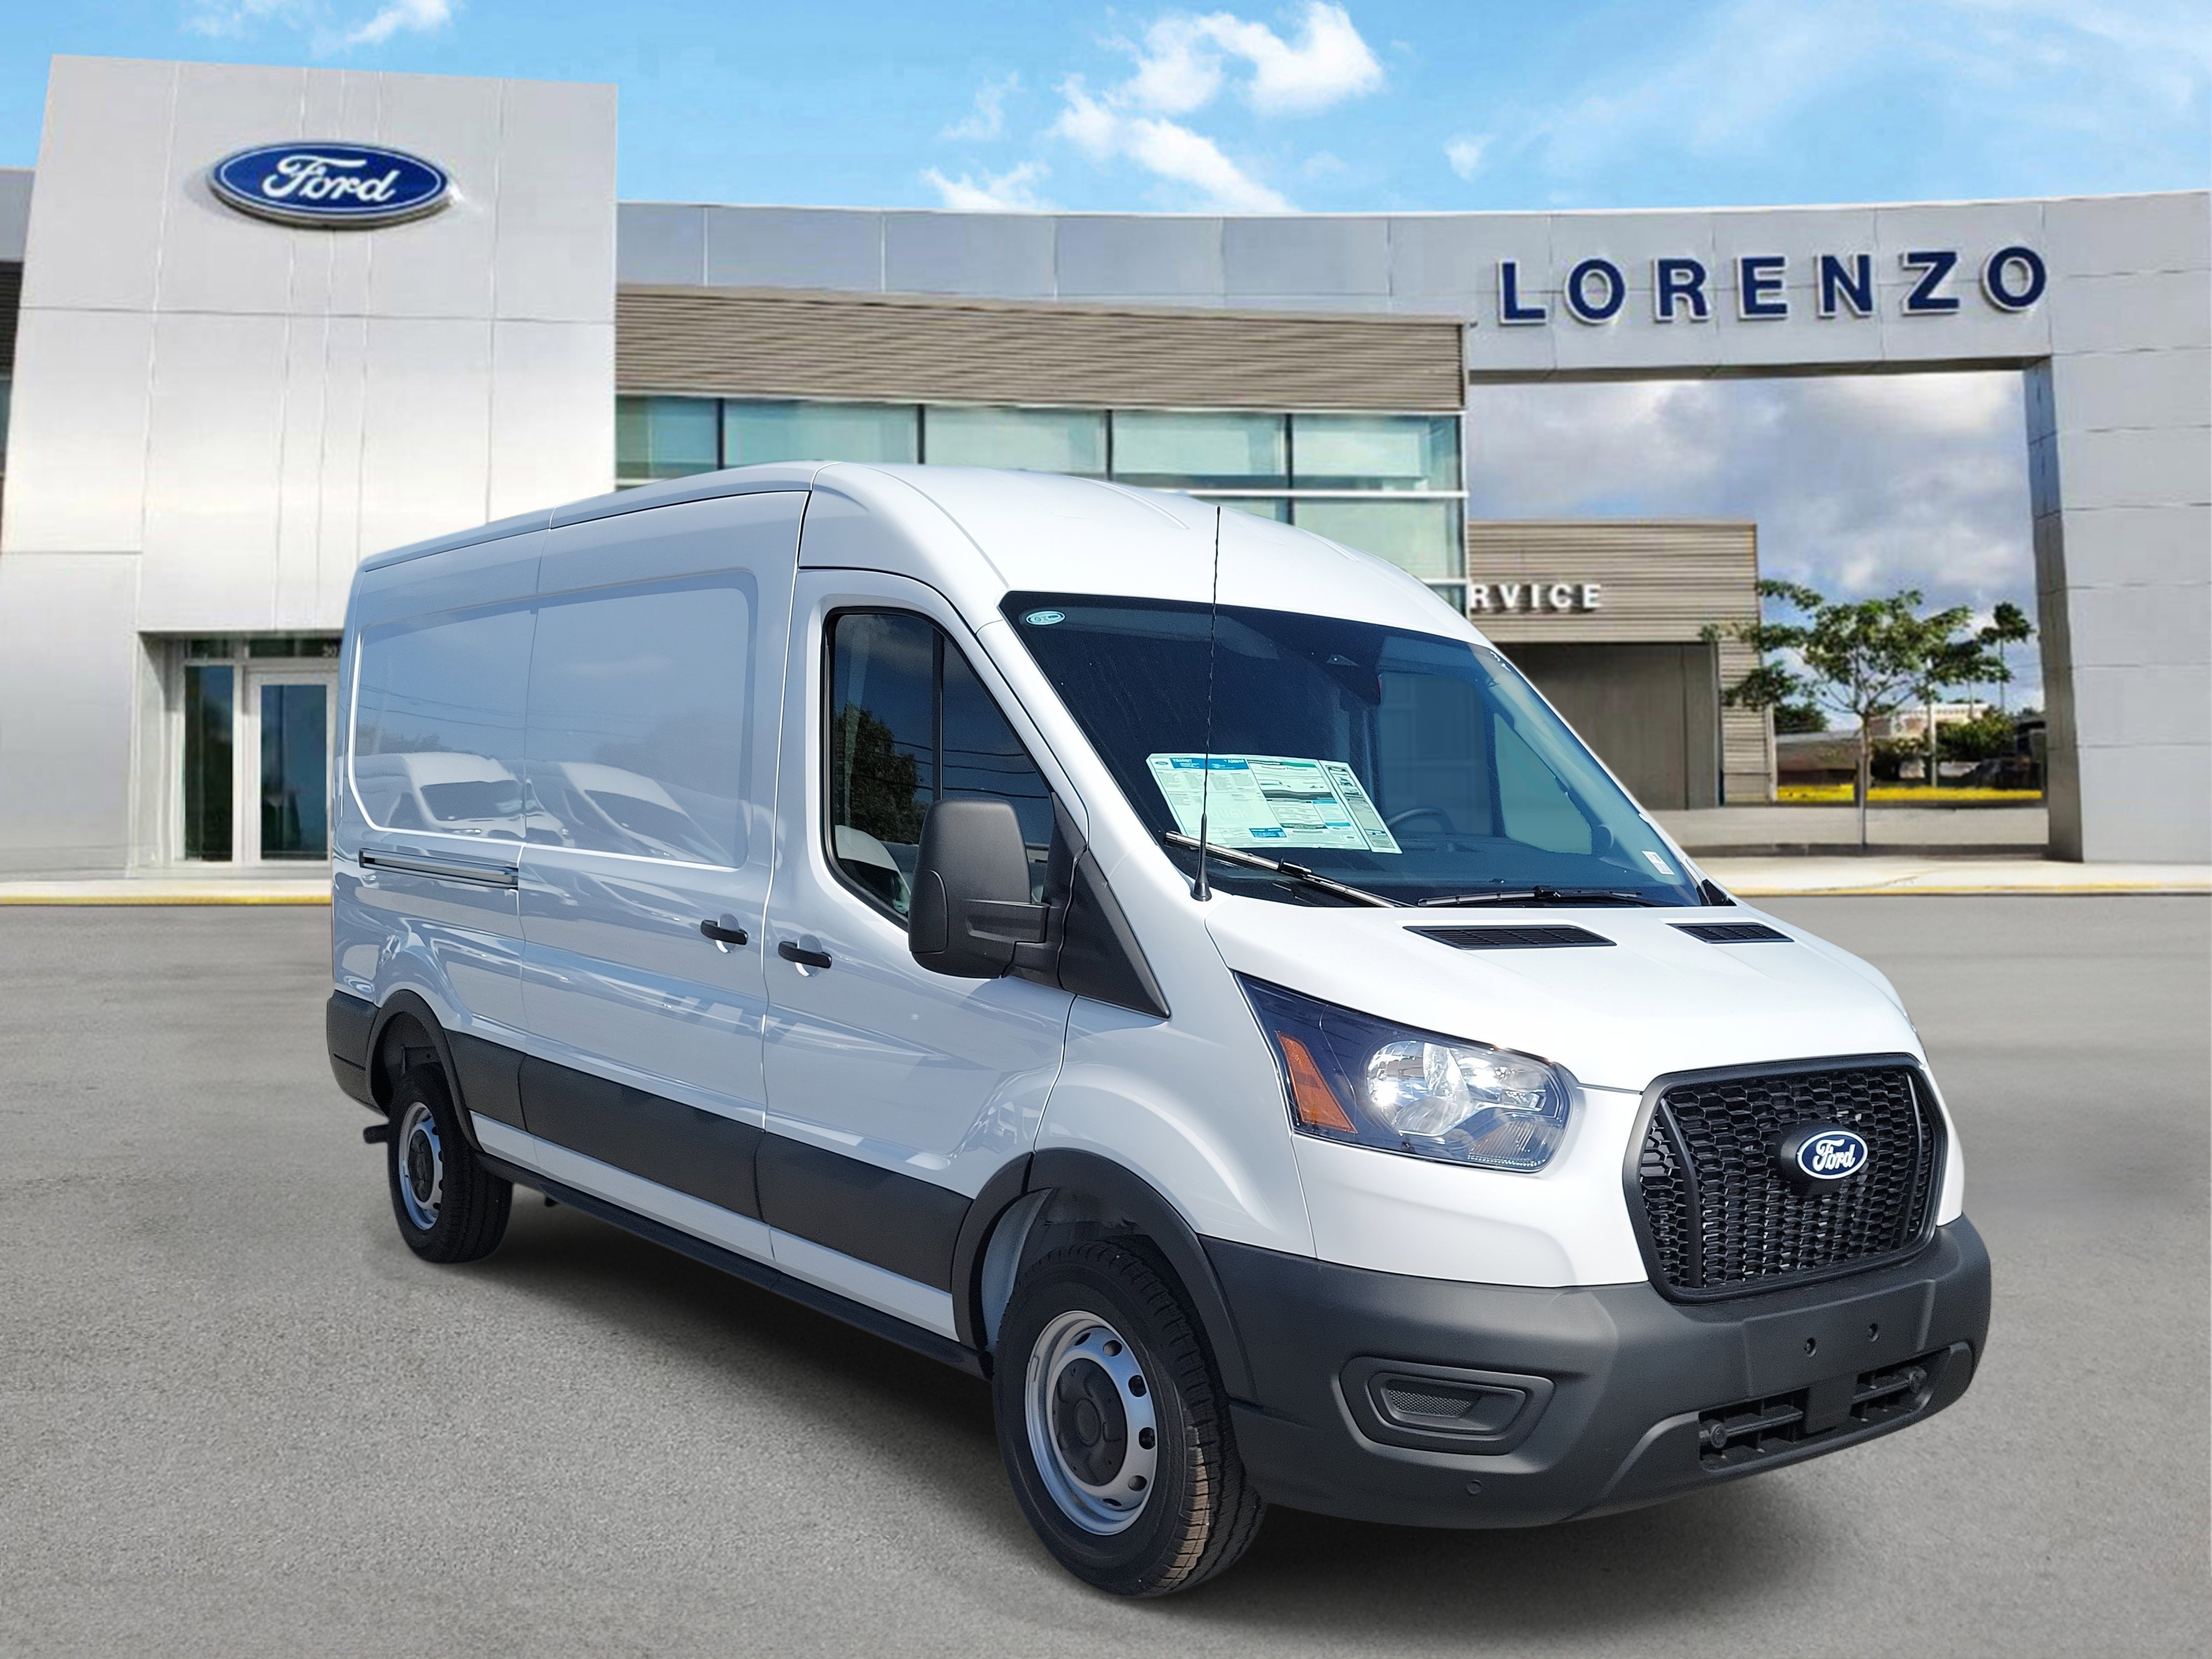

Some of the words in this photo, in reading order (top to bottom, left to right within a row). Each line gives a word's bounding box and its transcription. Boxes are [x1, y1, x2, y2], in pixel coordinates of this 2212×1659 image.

[262, 155, 400, 201] Ford
[1499, 247, 2046, 325] LORENZO
[1470, 584, 1601, 609] RVICE
[1812, 1139, 1856, 1172] Ford
